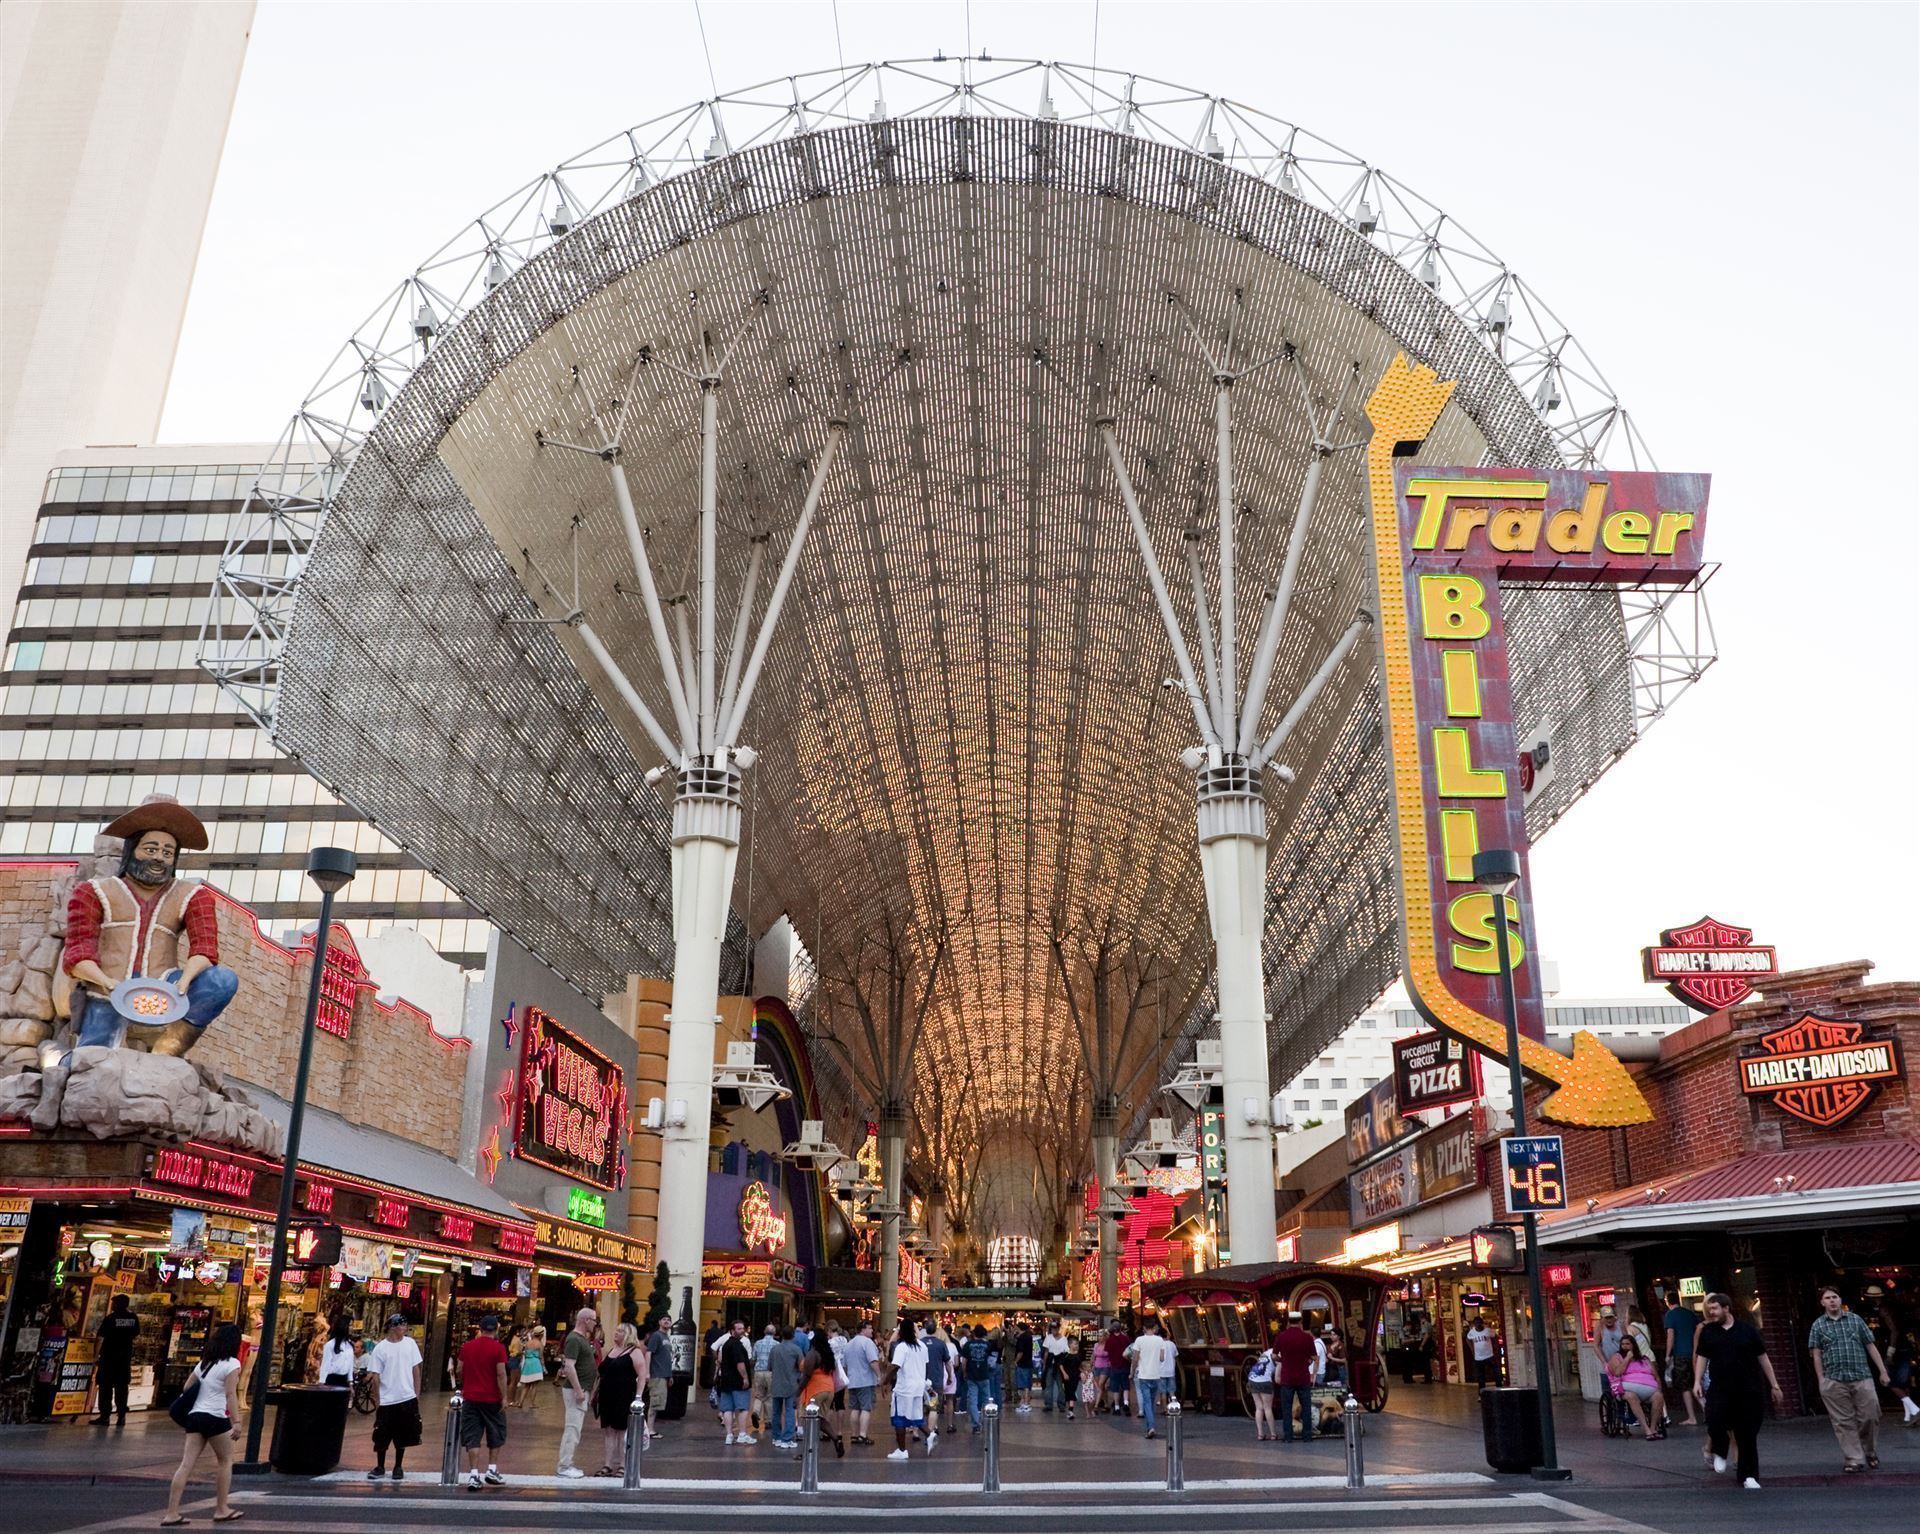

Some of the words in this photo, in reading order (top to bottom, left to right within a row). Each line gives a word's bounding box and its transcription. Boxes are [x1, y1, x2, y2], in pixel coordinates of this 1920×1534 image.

[1405, 478, 1695, 556] Trader
[1682, 926, 1740, 946] MOTOR
[1657, 951, 1771, 972] HARLEY-DAVIDSON
[320, 965, 356, 1009] ESTERN
[1688, 978, 1748, 1003] CYCLES
[315, 997, 350, 1040] ILLAGE
[1401, 1040, 1441, 1060] PICCADILLY
[1775, 1022, 1850, 1052] MOTOR
[1409, 1053, 1435, 1069] CIRCUS
[1747, 1047, 1889, 1087] HARLEY-DAVIDSON
[557, 1042, 601, 1113] VIVA
[1408, 1063, 1462, 1098] PIZZA
[1785, 1083, 1858, 1120] CYCLES
[544, 1093, 605, 1166] VEGAS
[1351, 1113, 1371, 1141] BUD
[856, 1135, 882, 1182] 4
[1436, 1131, 1472, 1179] PIZZA
[1507, 1143, 1531, 1154] NEXT
[1532, 1142, 1559, 1153] WALK
[1528, 1153, 1539, 1162] IN
[1508, 1163, 1562, 1204] 46
[0, 1200, 28, 1210] ENTER
[557, 1226, 593, 1253] SOUVENIRS
[597, 1237, 625, 1260] CLOTHING
[627, 1245, 647, 1265] LIQUOR
[580, 1278, 614, 1286] LIQUOR
[1686, 1277, 1704, 1294] ATM
[115, 1318, 136, 1327] SECURITY
